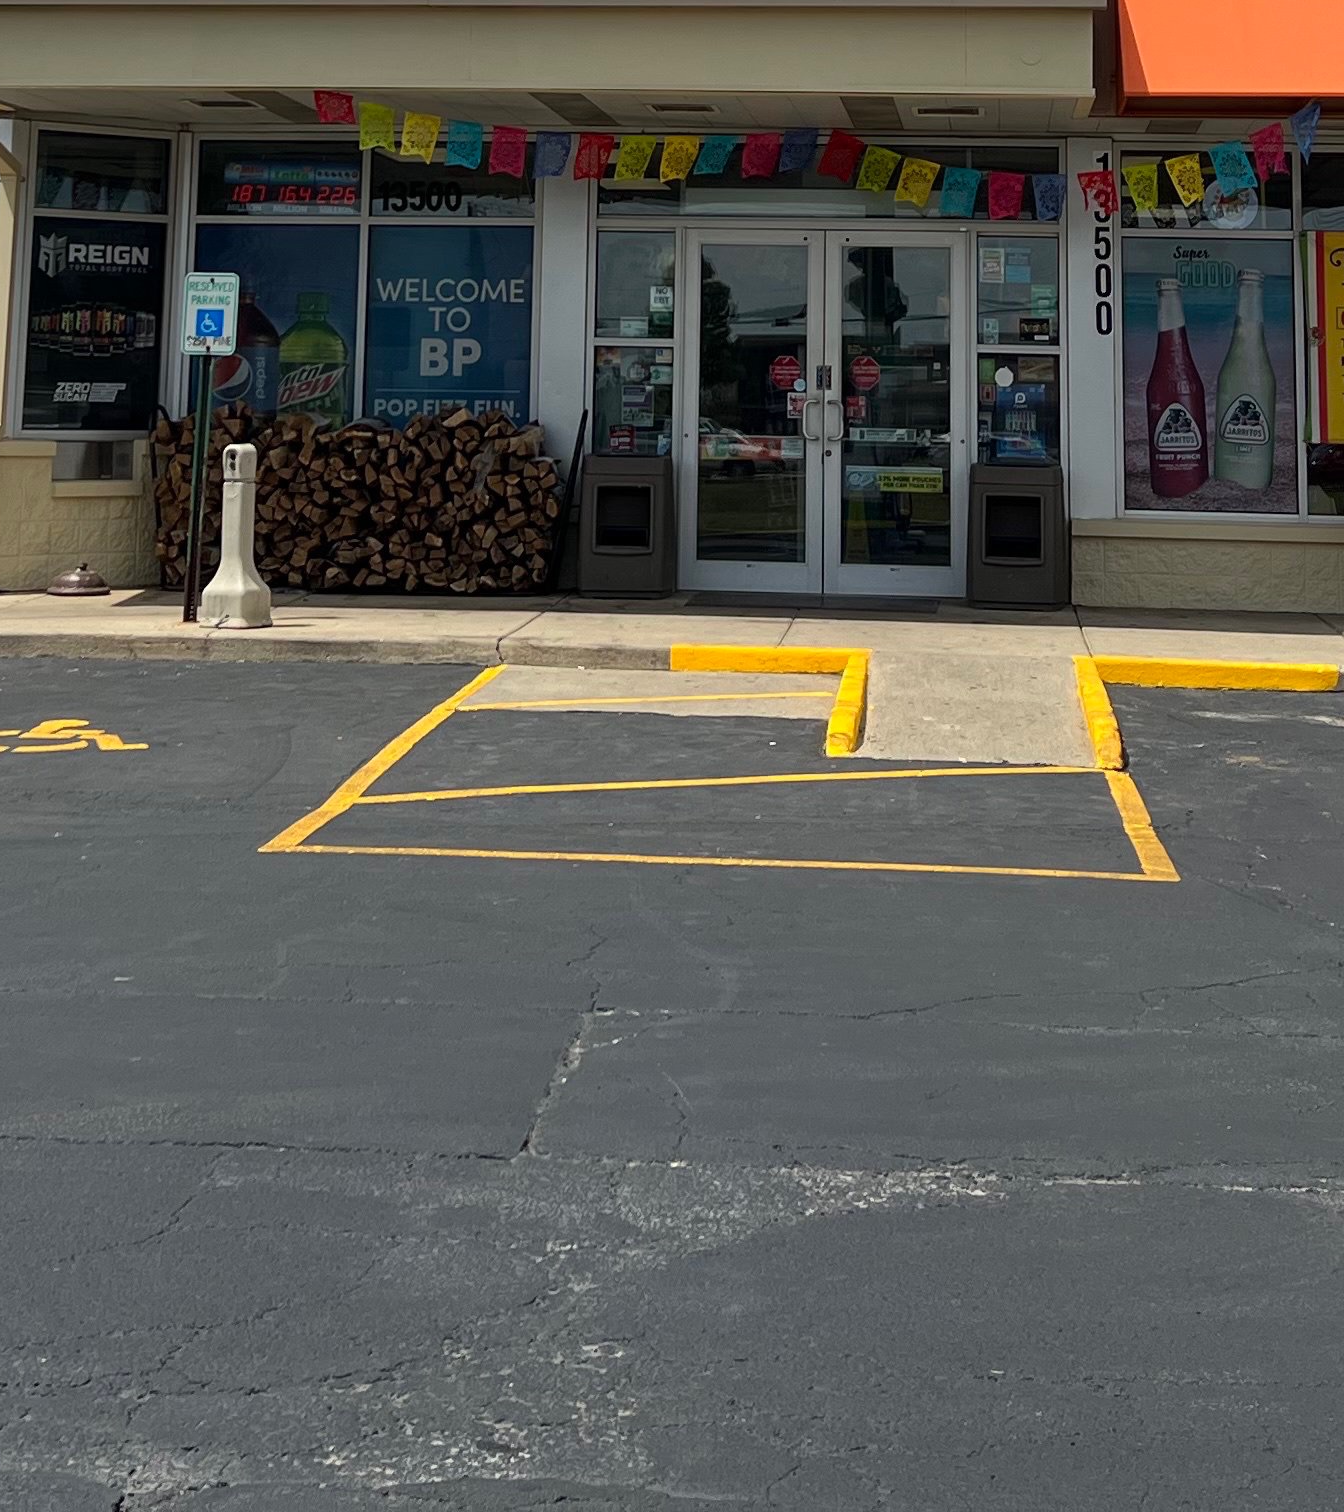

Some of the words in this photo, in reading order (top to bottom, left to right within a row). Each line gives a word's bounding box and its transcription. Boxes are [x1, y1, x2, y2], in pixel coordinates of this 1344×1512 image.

[277, 185, 313, 203] 164
[316, 185, 356, 204] 226
[381, 181, 462, 212] 13500
[68, 243, 150, 266] REIGN
[1173, 245, 1210, 260] Super
[1176, 260, 1236, 288] GOOD
[188, 281, 235, 293] RESERVED
[376, 278, 525, 303] WELCOME
[656, 287, 669, 295] NO
[191, 294, 232, 306] PARKING
[428, 306, 471, 333] TO
[419, 338, 483, 377] BP
[56, 381, 91, 392] ZERO
[256, 356, 267, 400] pepsi
[53, 392, 88, 403] SUGAR
[1160, 435, 1195, 444] JARRITOS
[1227, 427, 1262, 438] JARRITOS
